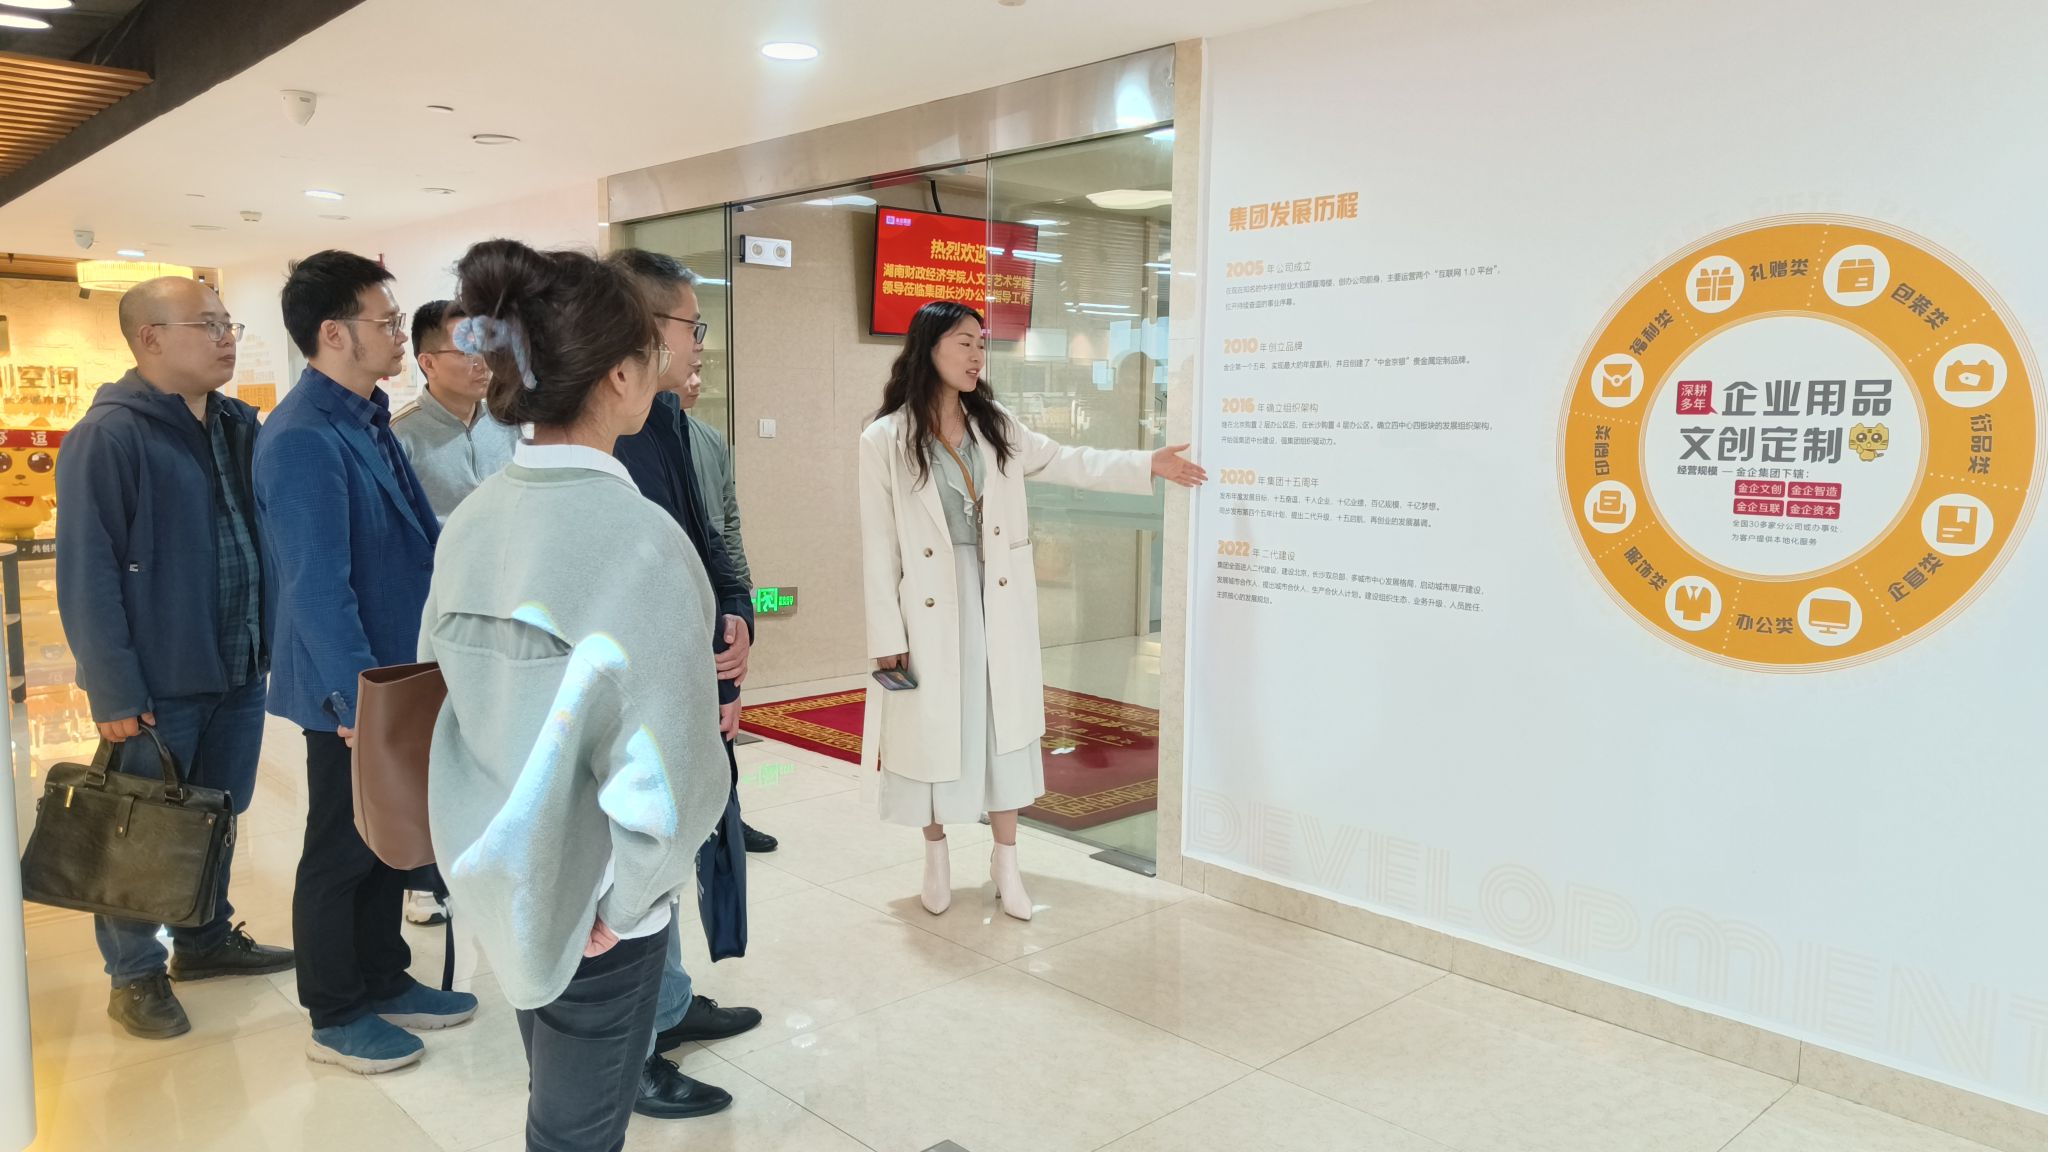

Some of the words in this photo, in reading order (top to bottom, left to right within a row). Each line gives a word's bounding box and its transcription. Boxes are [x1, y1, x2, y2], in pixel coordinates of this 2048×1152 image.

[1228, 191, 1359, 232] 集团发展历程
[1226, 260, 1264, 278] 2005
[1749, 258, 1810, 282] 礼赠类
[882, 281, 1031, 306] 领导莅临集团长沙办公指导工作
[1889, 282, 1949, 331] 包装类
[1629, 308, 1675, 356] 福利类
[1223, 338, 1258, 354] 2010
[1681, 384, 1708, 397] 深耕
[1721, 379, 1892, 417] 企业用品
[1221, 397, 1255, 413] 2016
[1680, 398, 1707, 411] 多年
[1594, 424, 1611, 476] 印刷类
[1679, 426, 1843, 464] 文创定制
[1969, 413, 1994, 475] 衍品类
[1219, 469, 1256, 485] 2020
[1677, 465, 1718, 476] 经营规模
[1737, 483, 1782, 495] 金企文创
[1791, 486, 1838, 498] 金企智造
[1736, 501, 1781, 514] 金企互联
[1789, 504, 1836, 516] 金企资本
[1217, 540, 1250, 557] 2022
[1731, 534, 1817, 546] 为客户提供本地化服务
[1623, 545, 1669, 592] 服饰类
[1887, 552, 1944, 602] 企宣类
[1736, 613, 1793, 635] 办公类
